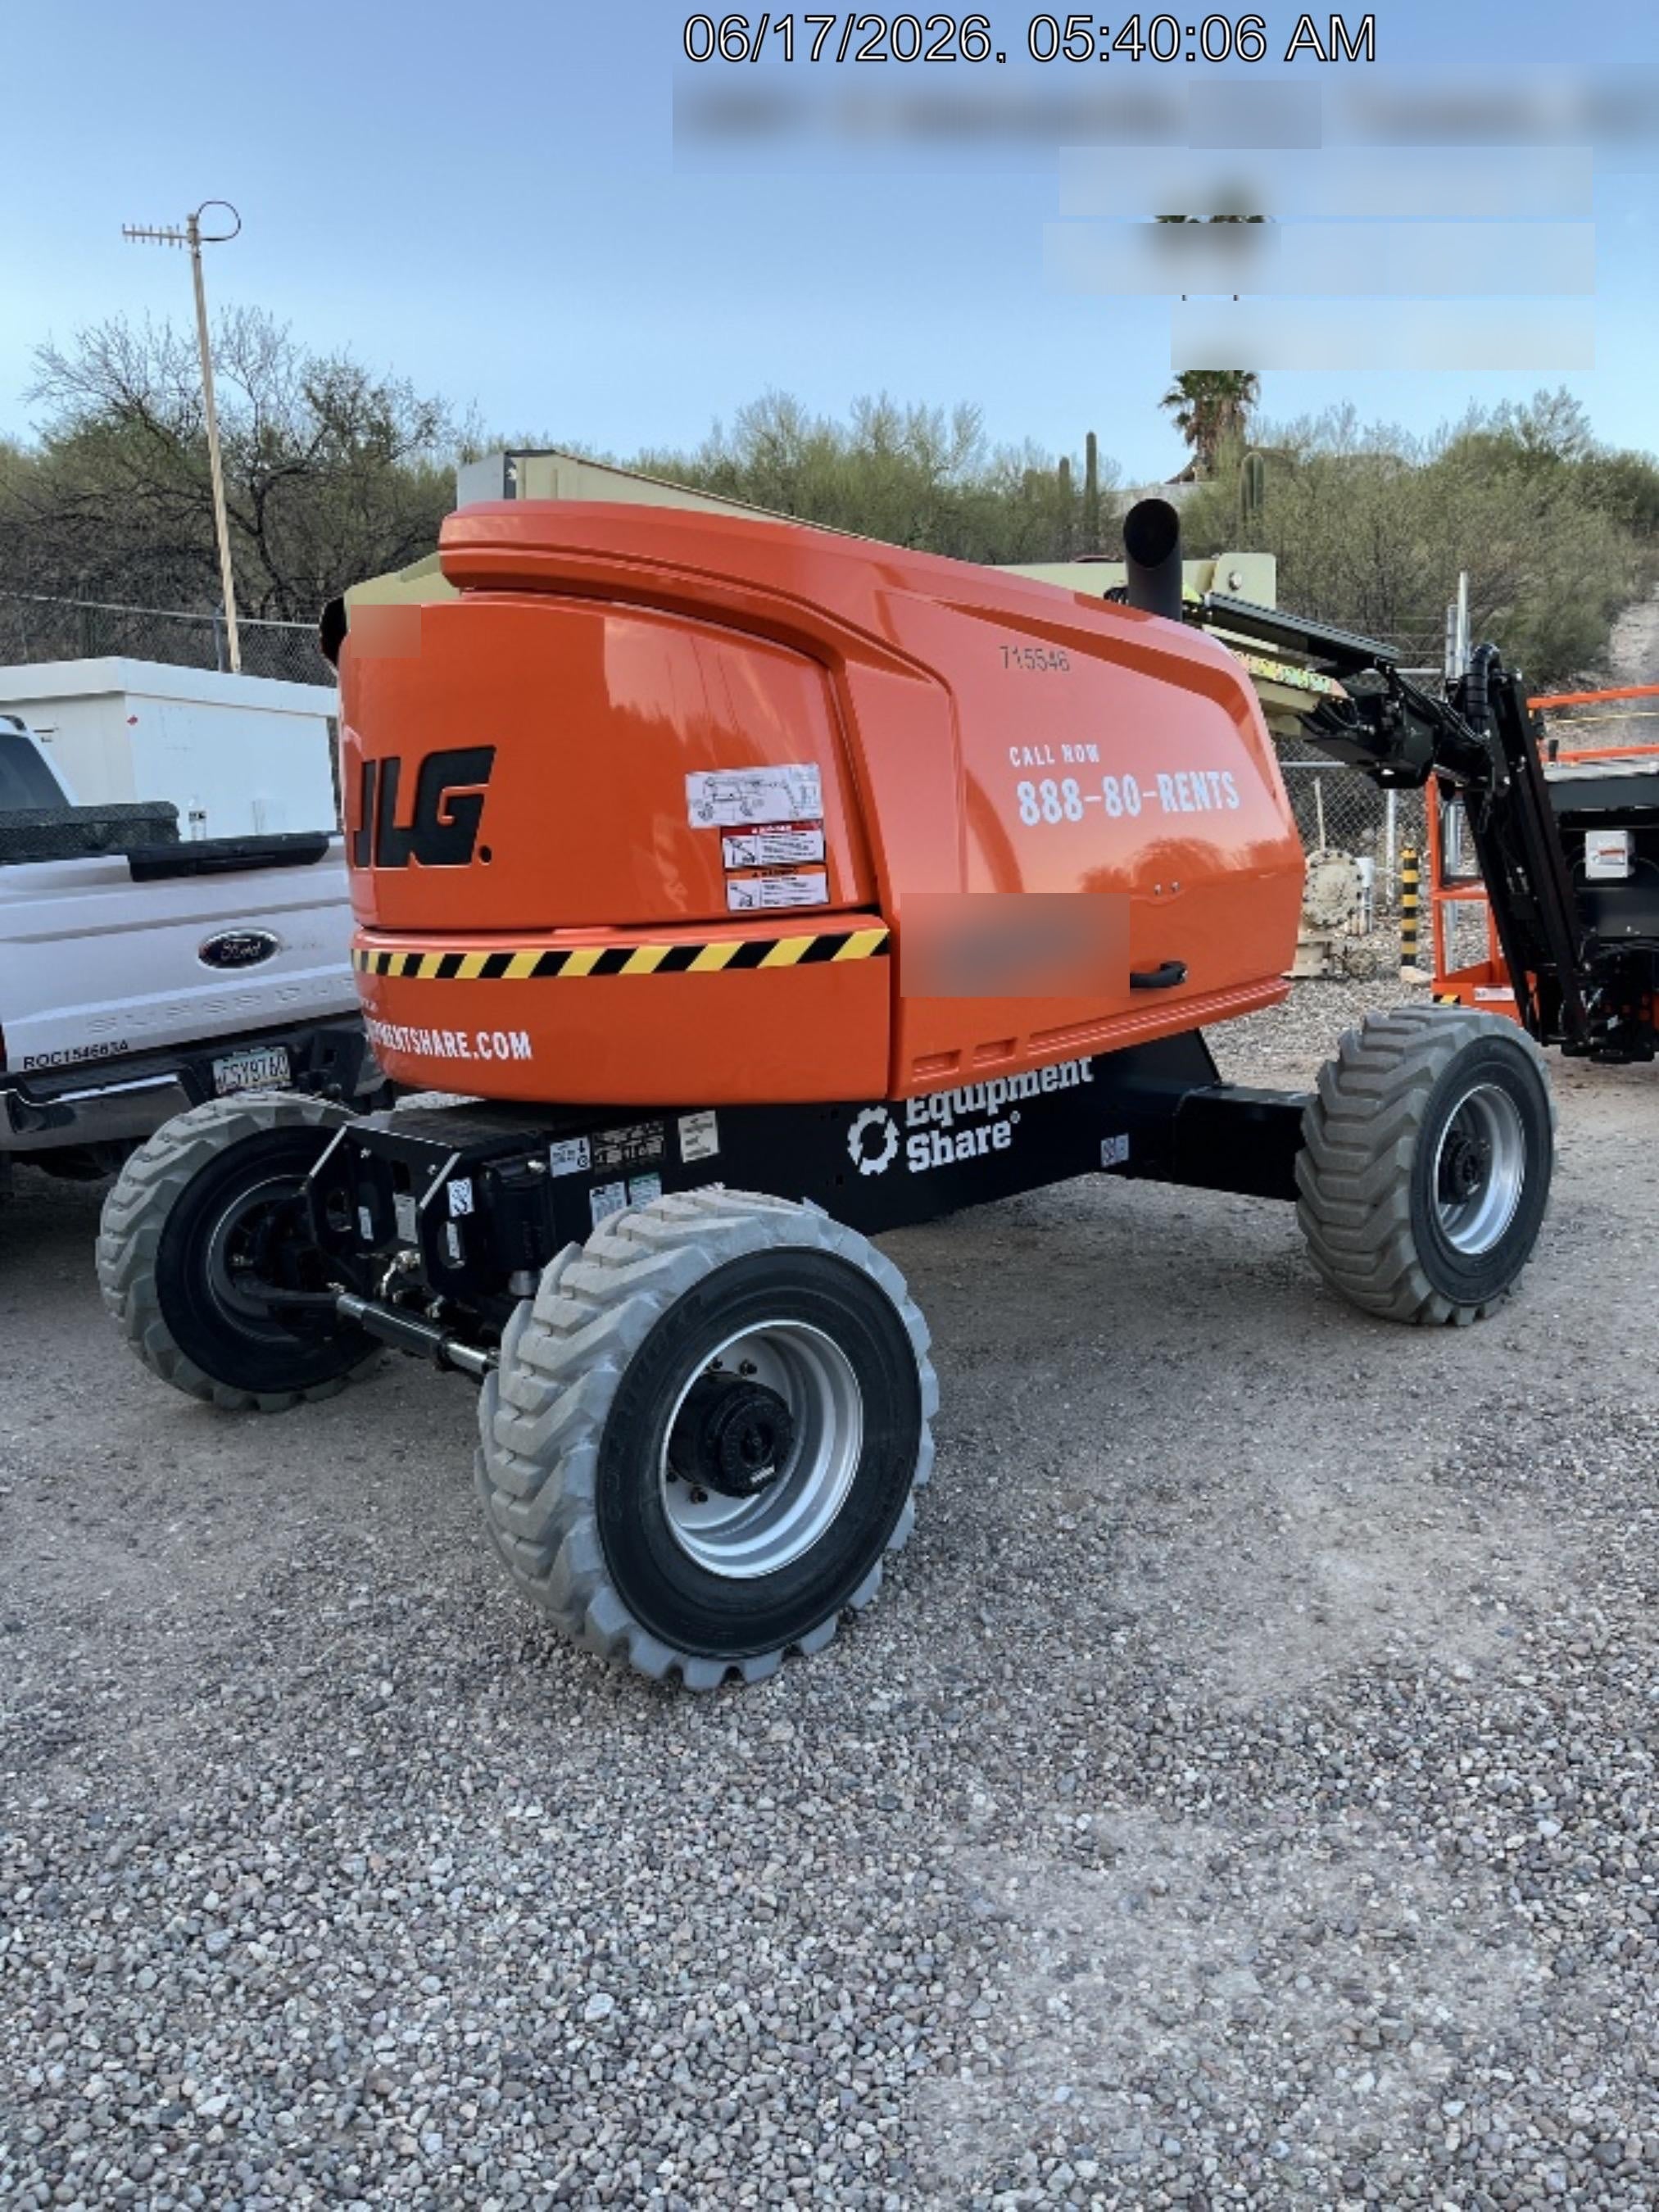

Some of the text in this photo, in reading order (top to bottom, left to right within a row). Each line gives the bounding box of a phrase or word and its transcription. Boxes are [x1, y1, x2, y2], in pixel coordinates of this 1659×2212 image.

[999, 645, 1071, 672] 715546
[1009, 743, 1100, 767] CALL NOW
[1017, 771, 1240, 826] 888-80-RENTS
[906, 1056, 1095, 1127] Equipment
